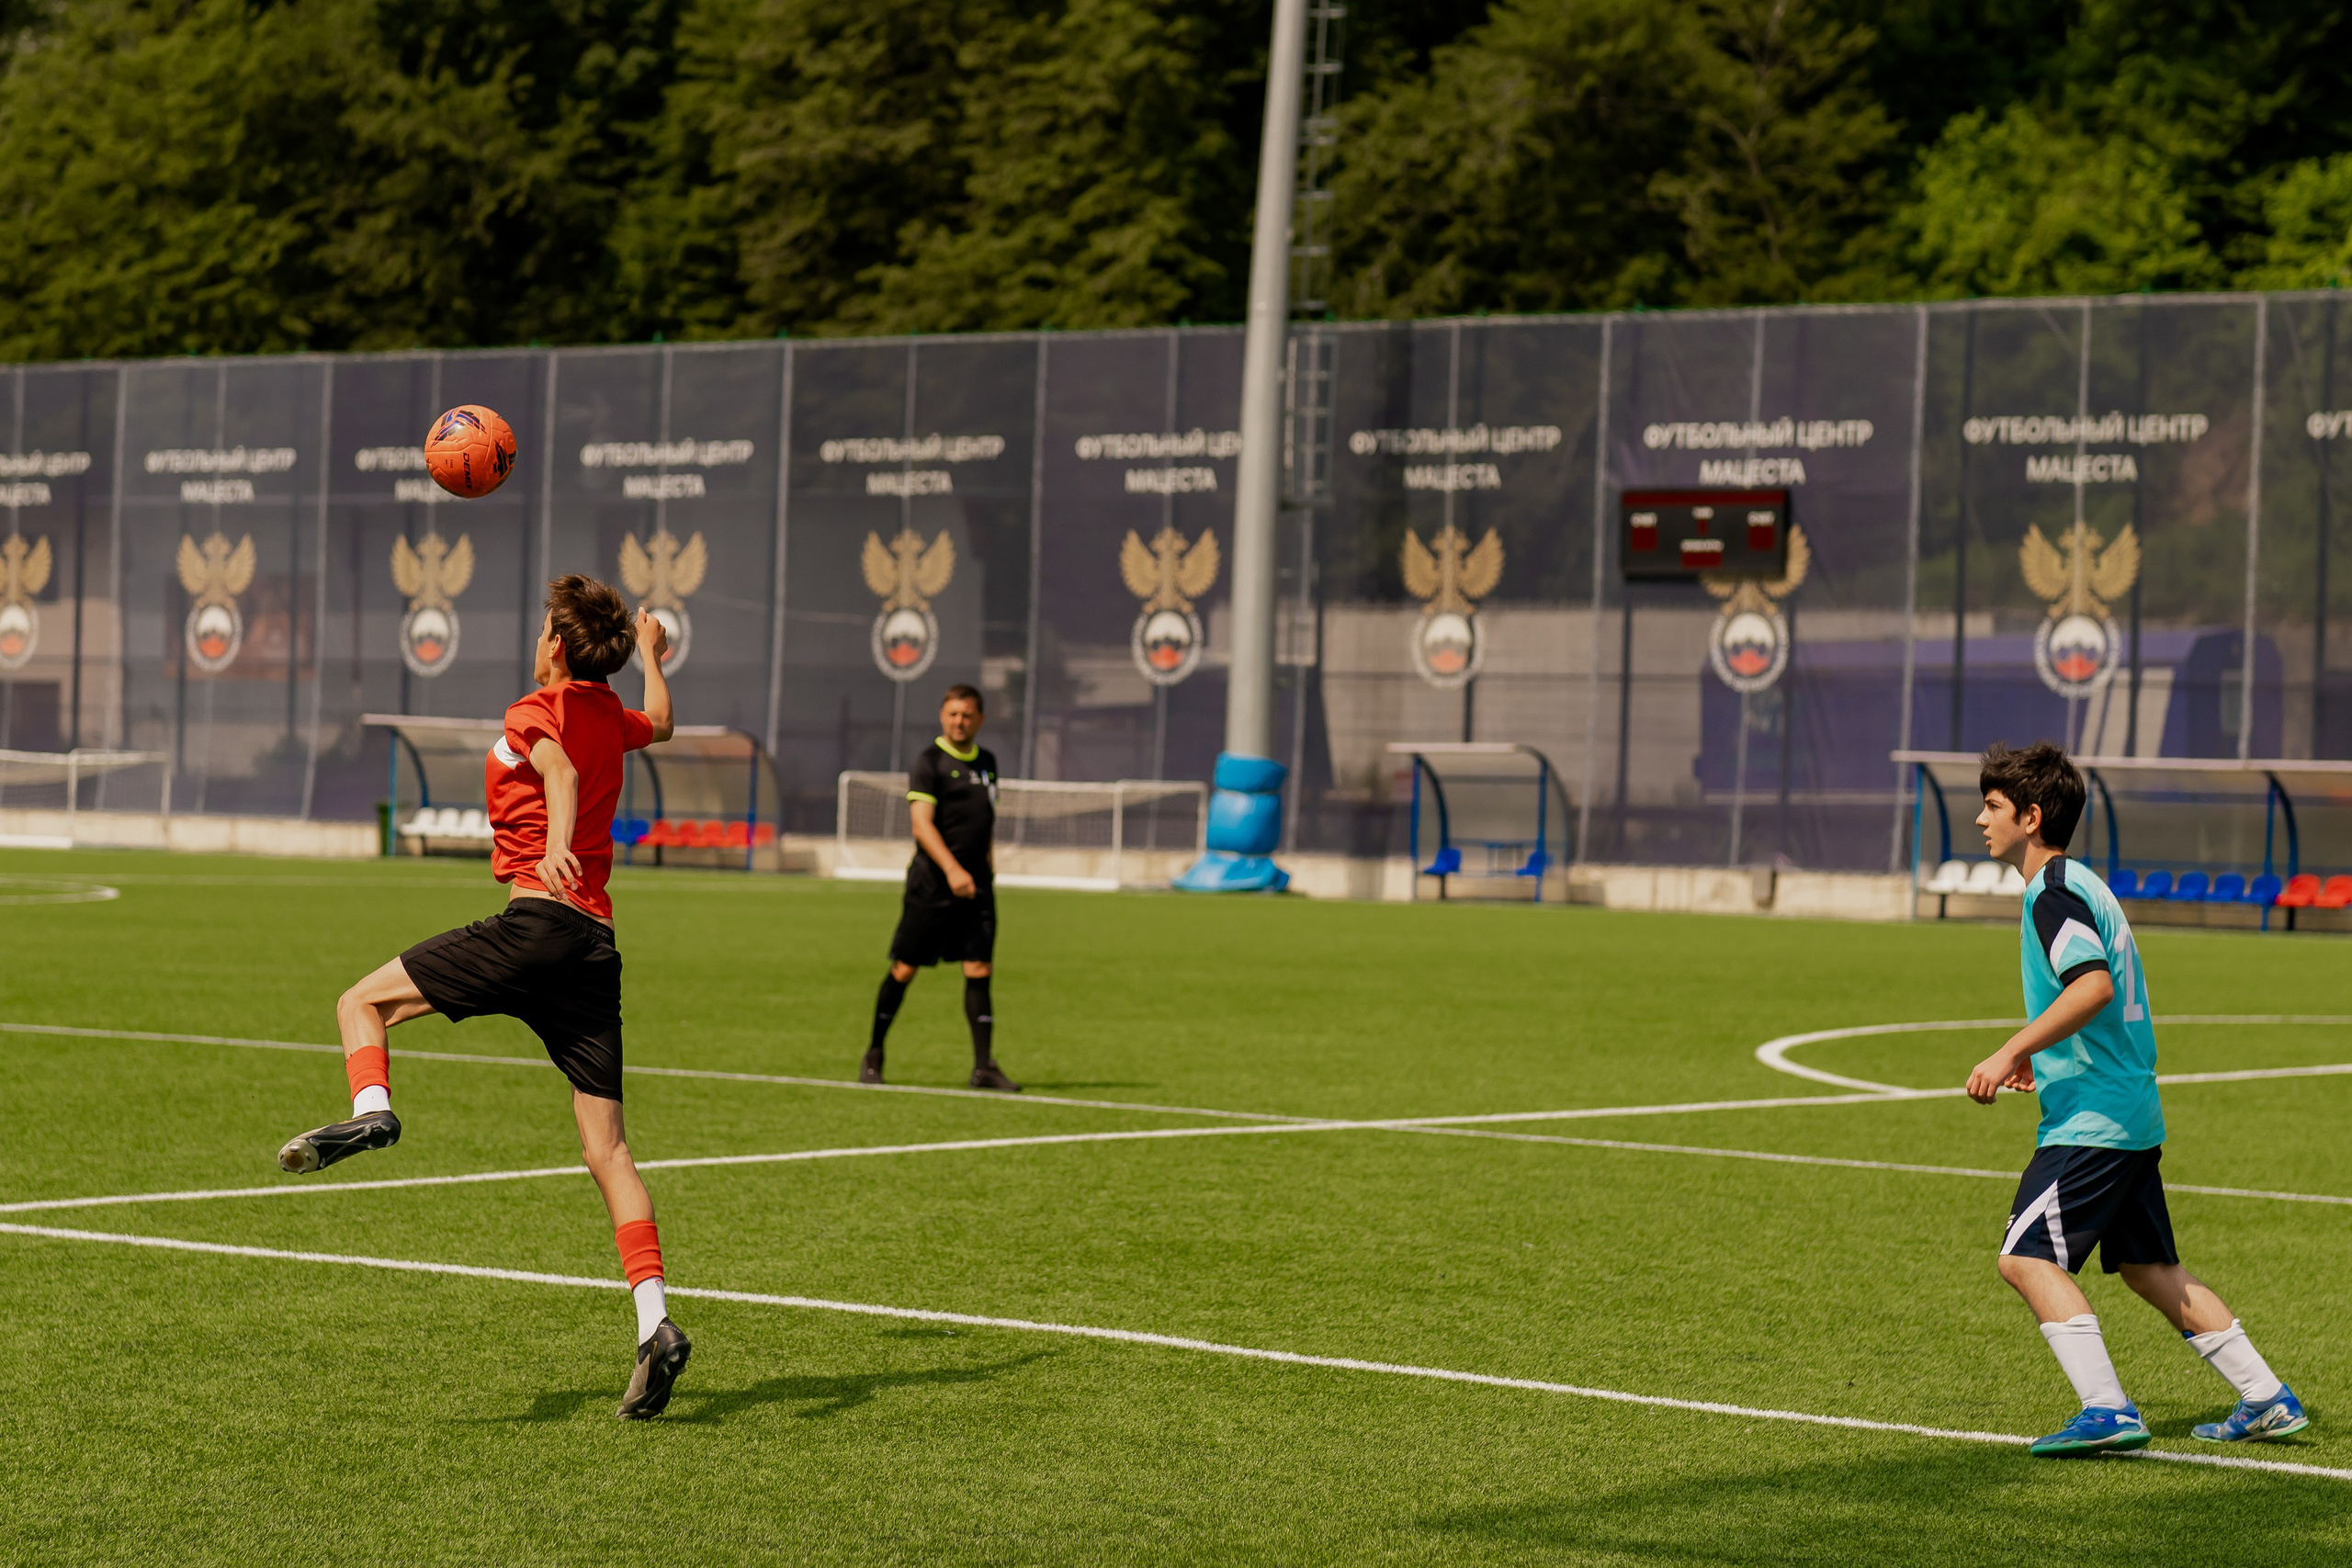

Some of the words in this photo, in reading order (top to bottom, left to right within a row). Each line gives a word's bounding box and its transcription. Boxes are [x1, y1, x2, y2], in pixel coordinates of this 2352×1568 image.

[1490, 425, 1562, 457] ЦЕНТР
[1643, 416, 1794, 449] ФУТБОЛЬНЫЙ
[1796, 419, 1873, 451] ЦЕНТР
[1963, 410, 2125, 444] ФУТБОЛЬНЫЙ
[2127, 413, 2209, 446] ЦЕНТР
[463, 452, 473, 490] DEMIX
[1404, 463, 1501, 493] МАЦЕСТА
[1699, 457, 1806, 489] МАЦЕСТА
[2026, 454, 2138, 485] МАЦЕСТА
